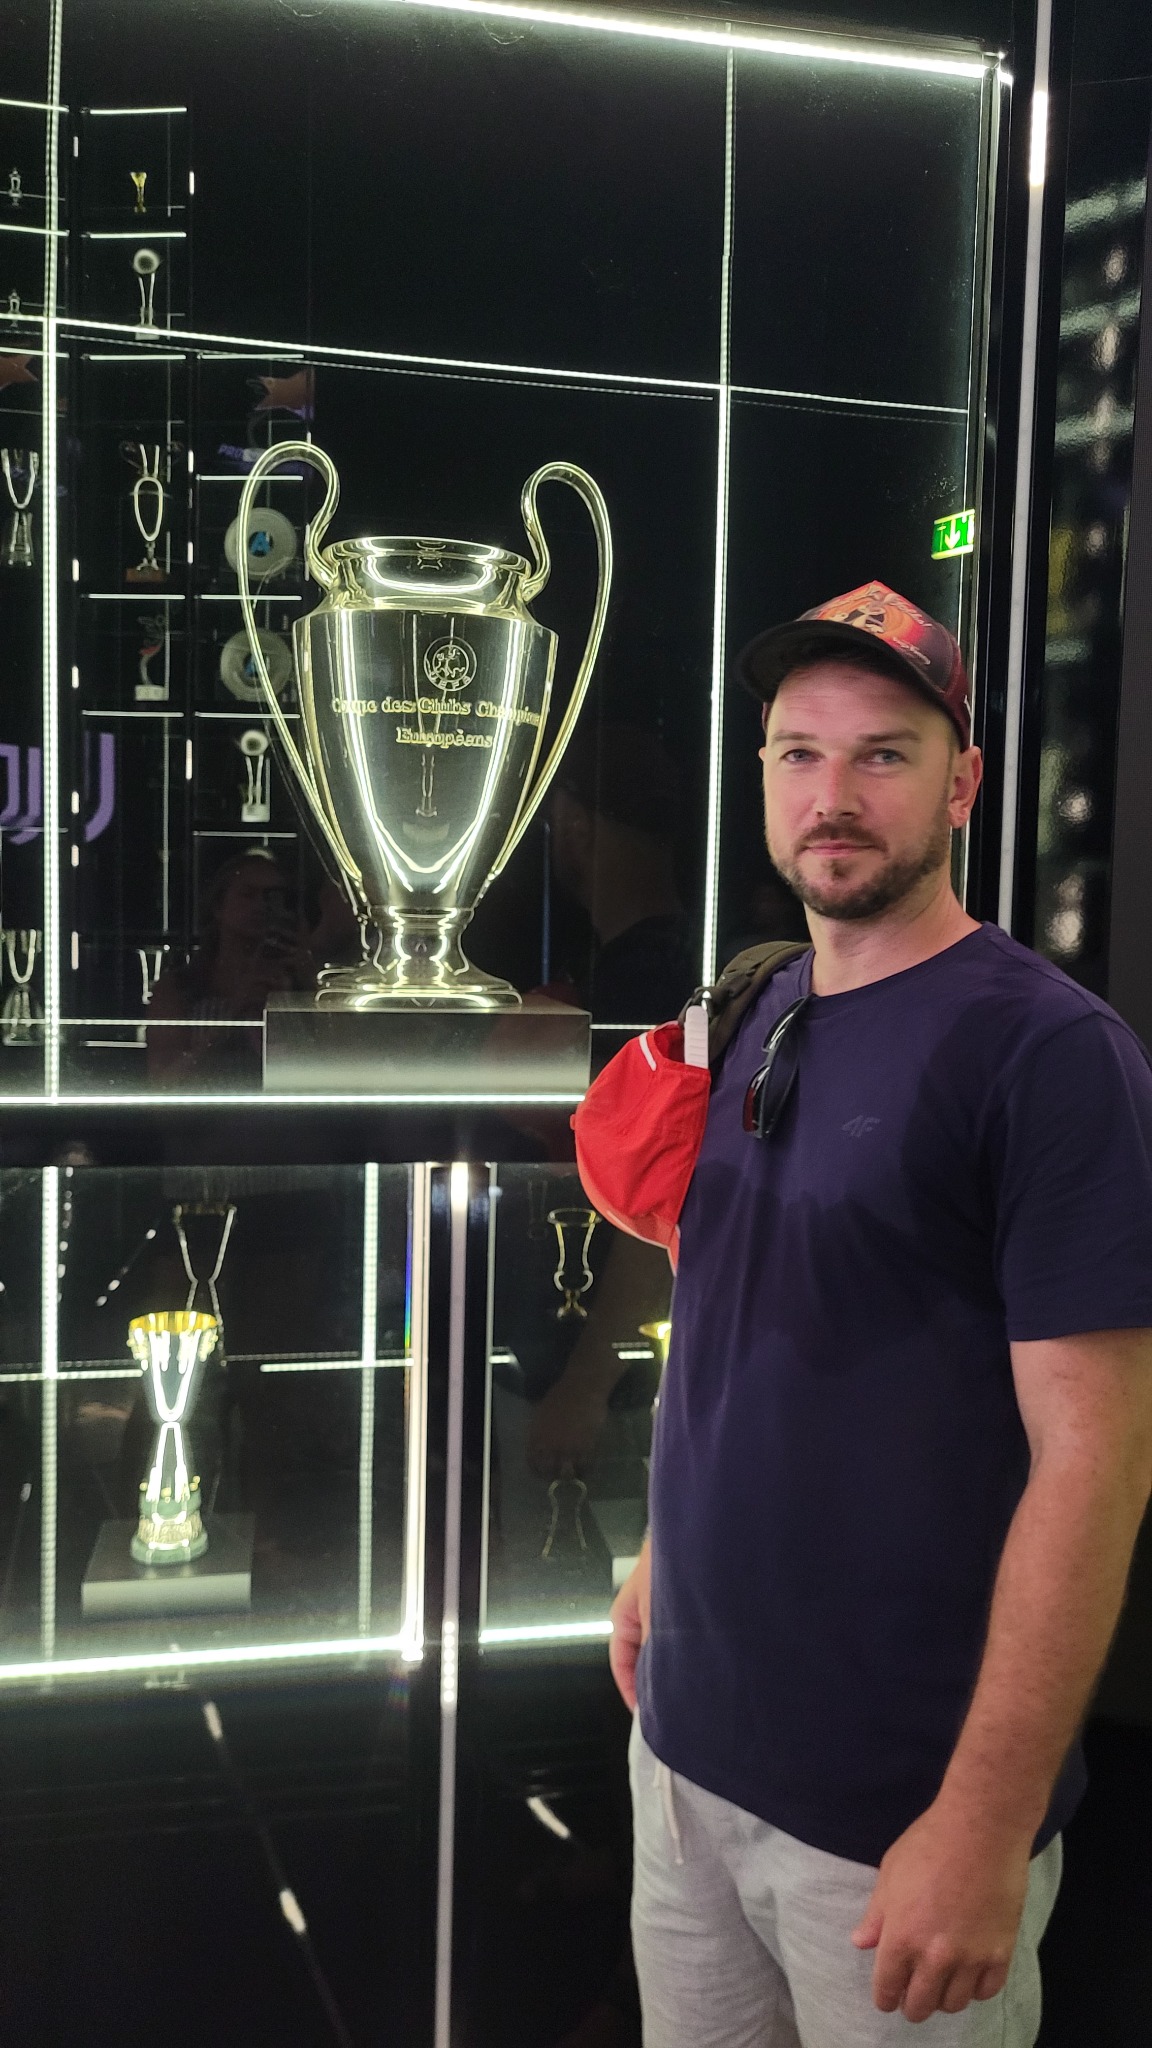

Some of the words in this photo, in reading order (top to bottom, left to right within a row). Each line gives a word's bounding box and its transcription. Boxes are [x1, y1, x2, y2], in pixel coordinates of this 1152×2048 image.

[382, 696, 416, 713] des
[418, 697, 471, 715] Clubs
[841, 1115, 880, 1137] 4F
